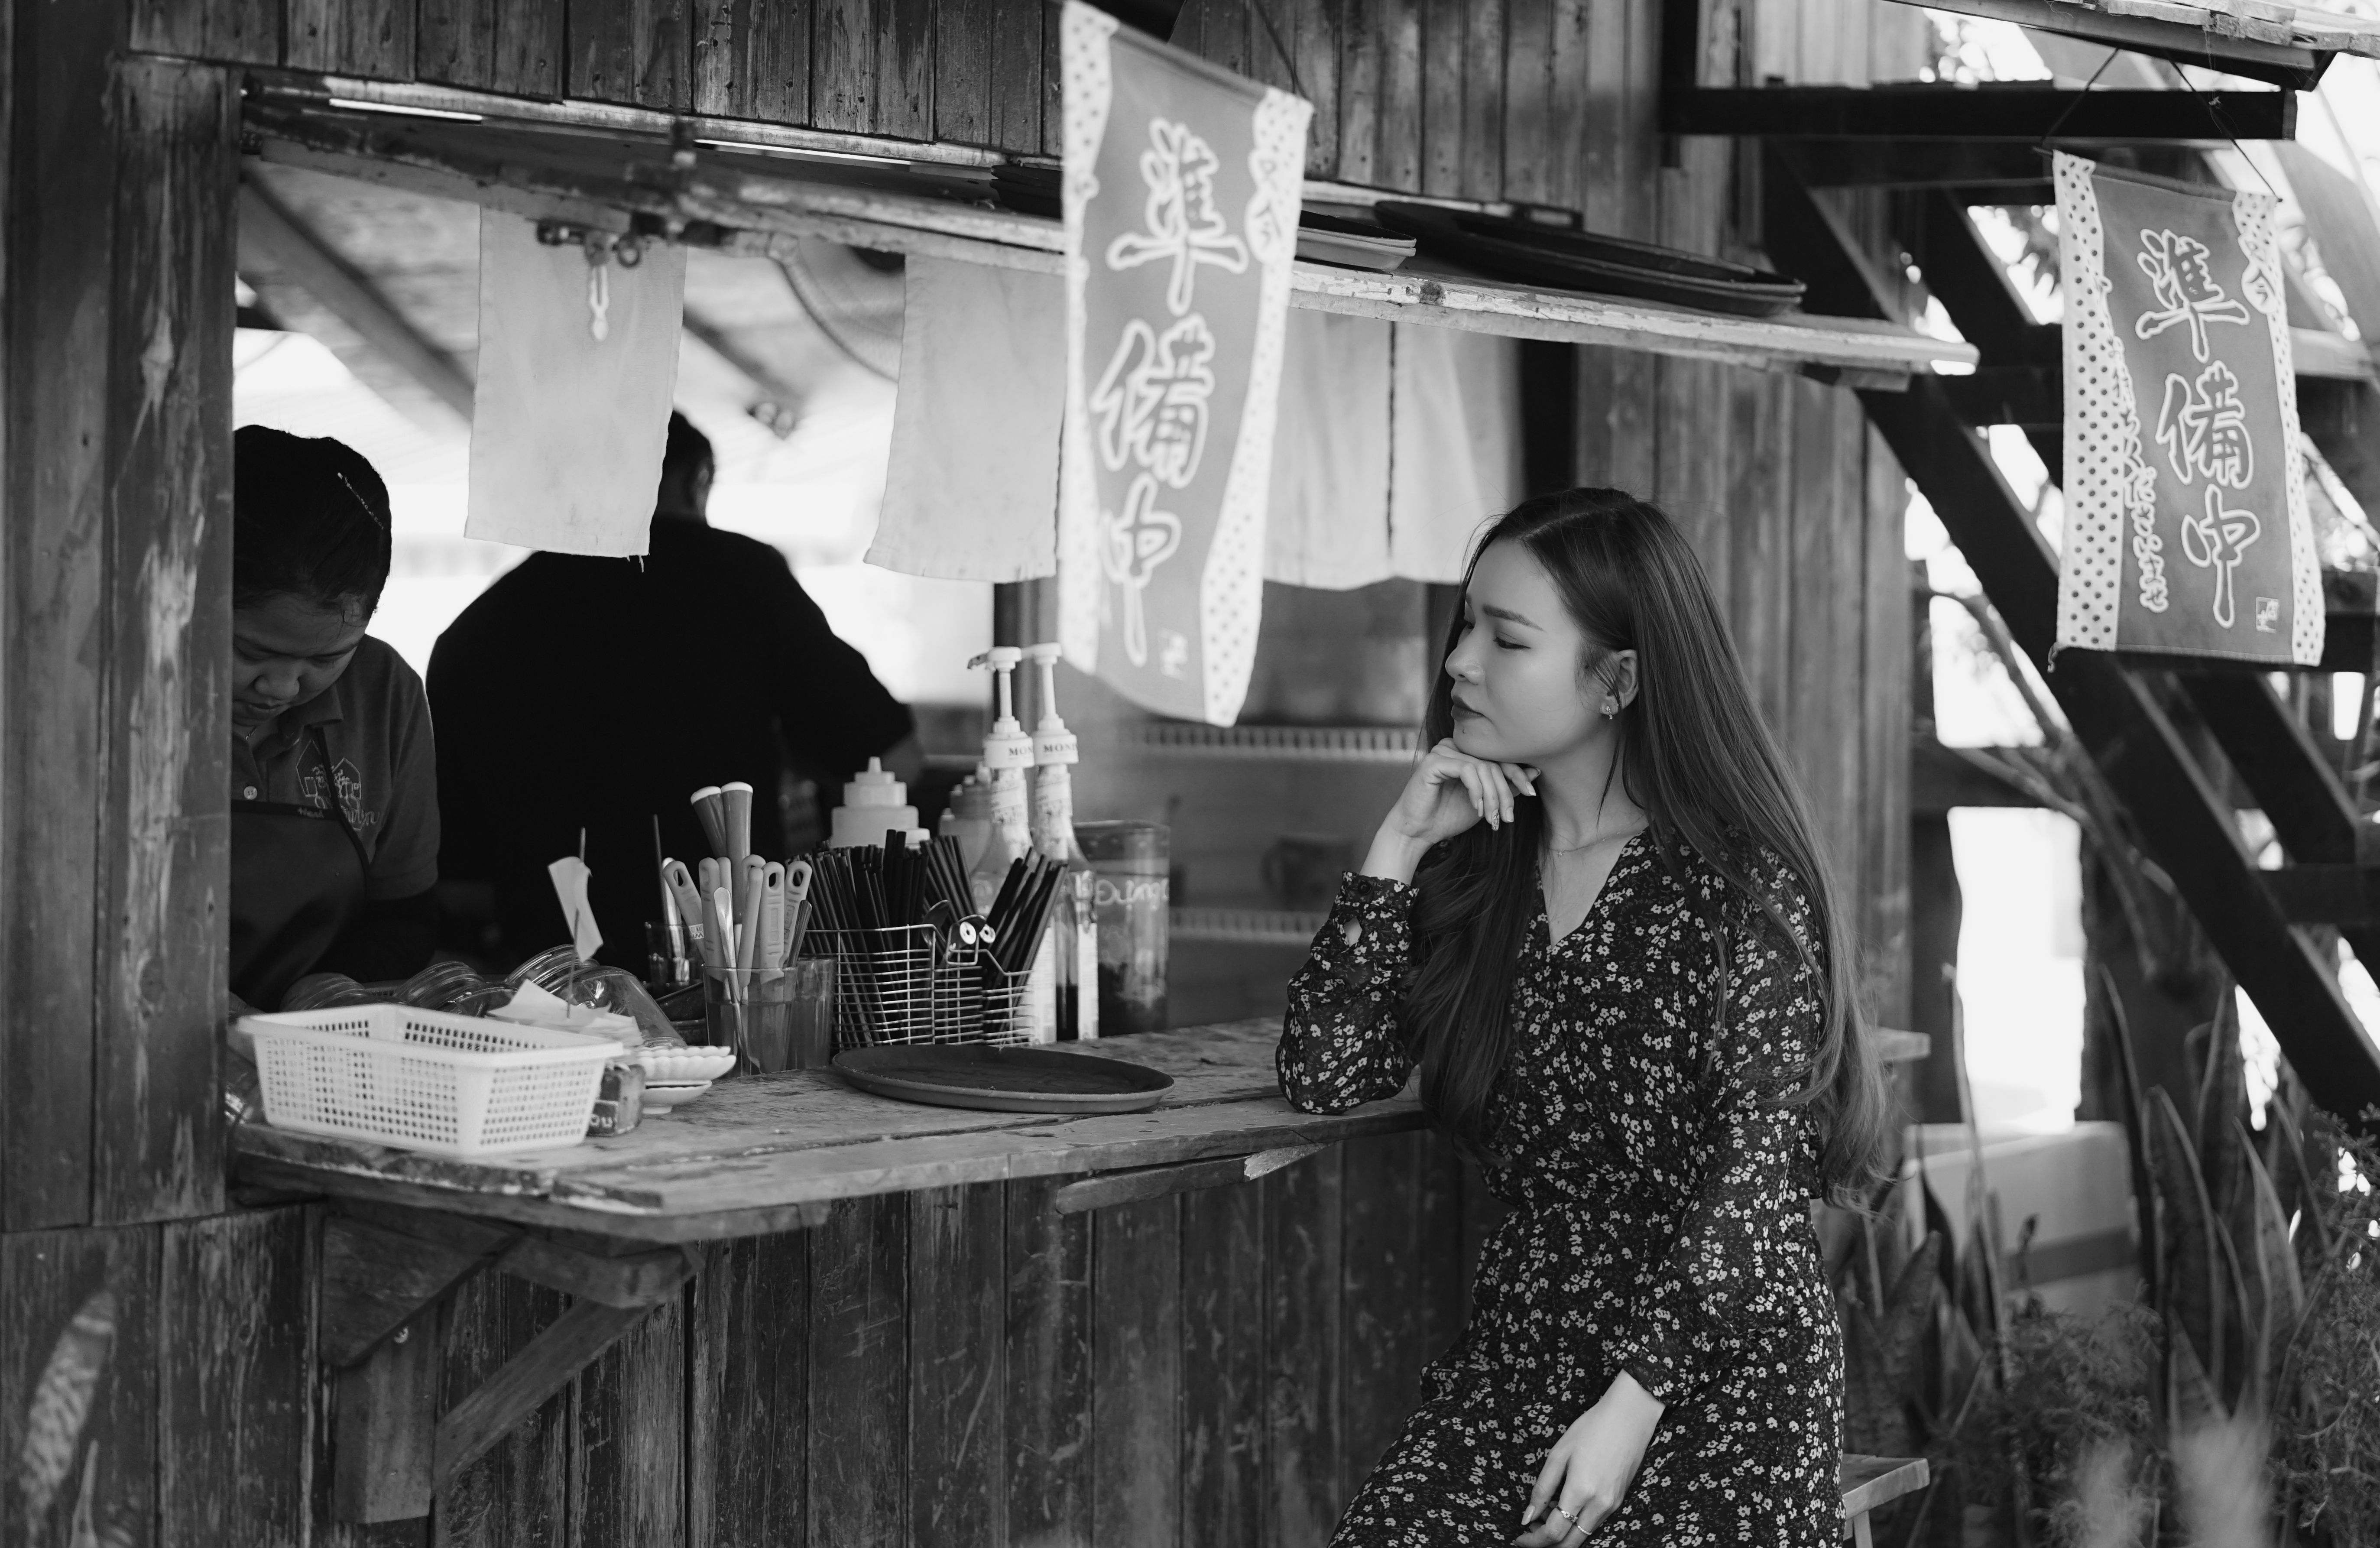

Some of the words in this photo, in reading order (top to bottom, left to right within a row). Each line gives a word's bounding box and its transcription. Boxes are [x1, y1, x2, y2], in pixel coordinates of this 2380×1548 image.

[1091, 117, 1248, 668] 準備中
[2135, 229, 2259, 628] 準備中
